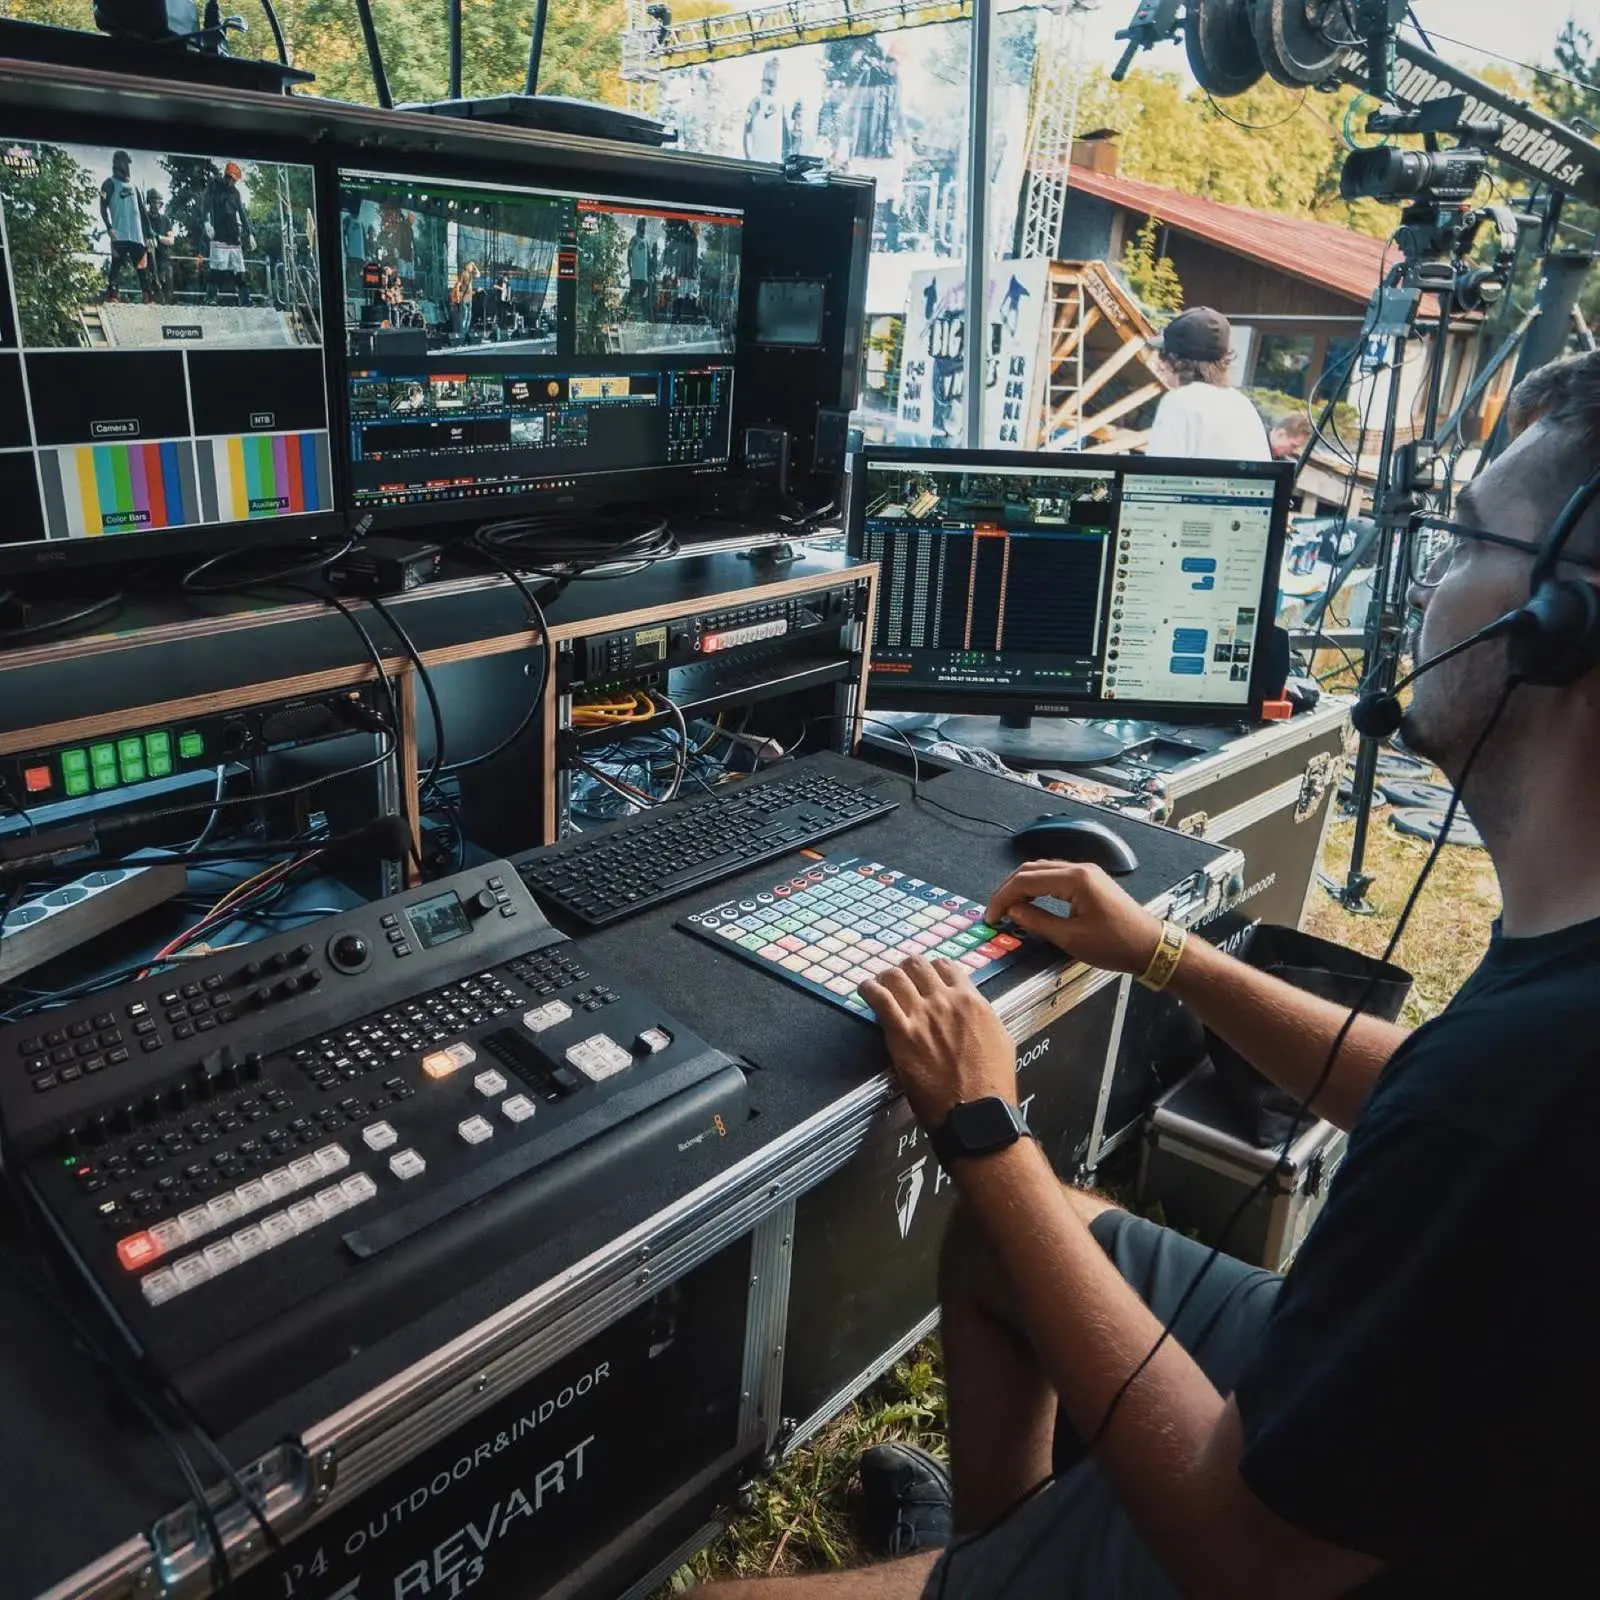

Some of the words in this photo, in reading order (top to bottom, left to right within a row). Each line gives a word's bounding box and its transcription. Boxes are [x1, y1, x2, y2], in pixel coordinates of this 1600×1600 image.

[165, 327, 200, 338] Program
[254, 416, 271, 424] NTB
[96, 424, 127, 434] Camera
[128, 423, 135, 432] 3
[251, 499, 281, 509] Auxiliary
[105, 515, 127, 525] Color
[128, 513, 147, 523] Bars
[897, 1130, 918, 1158] P4
[344, 1360, 612, 1555] OUTDOOR&INDOOR
[393, 1434, 597, 1600] REVART
